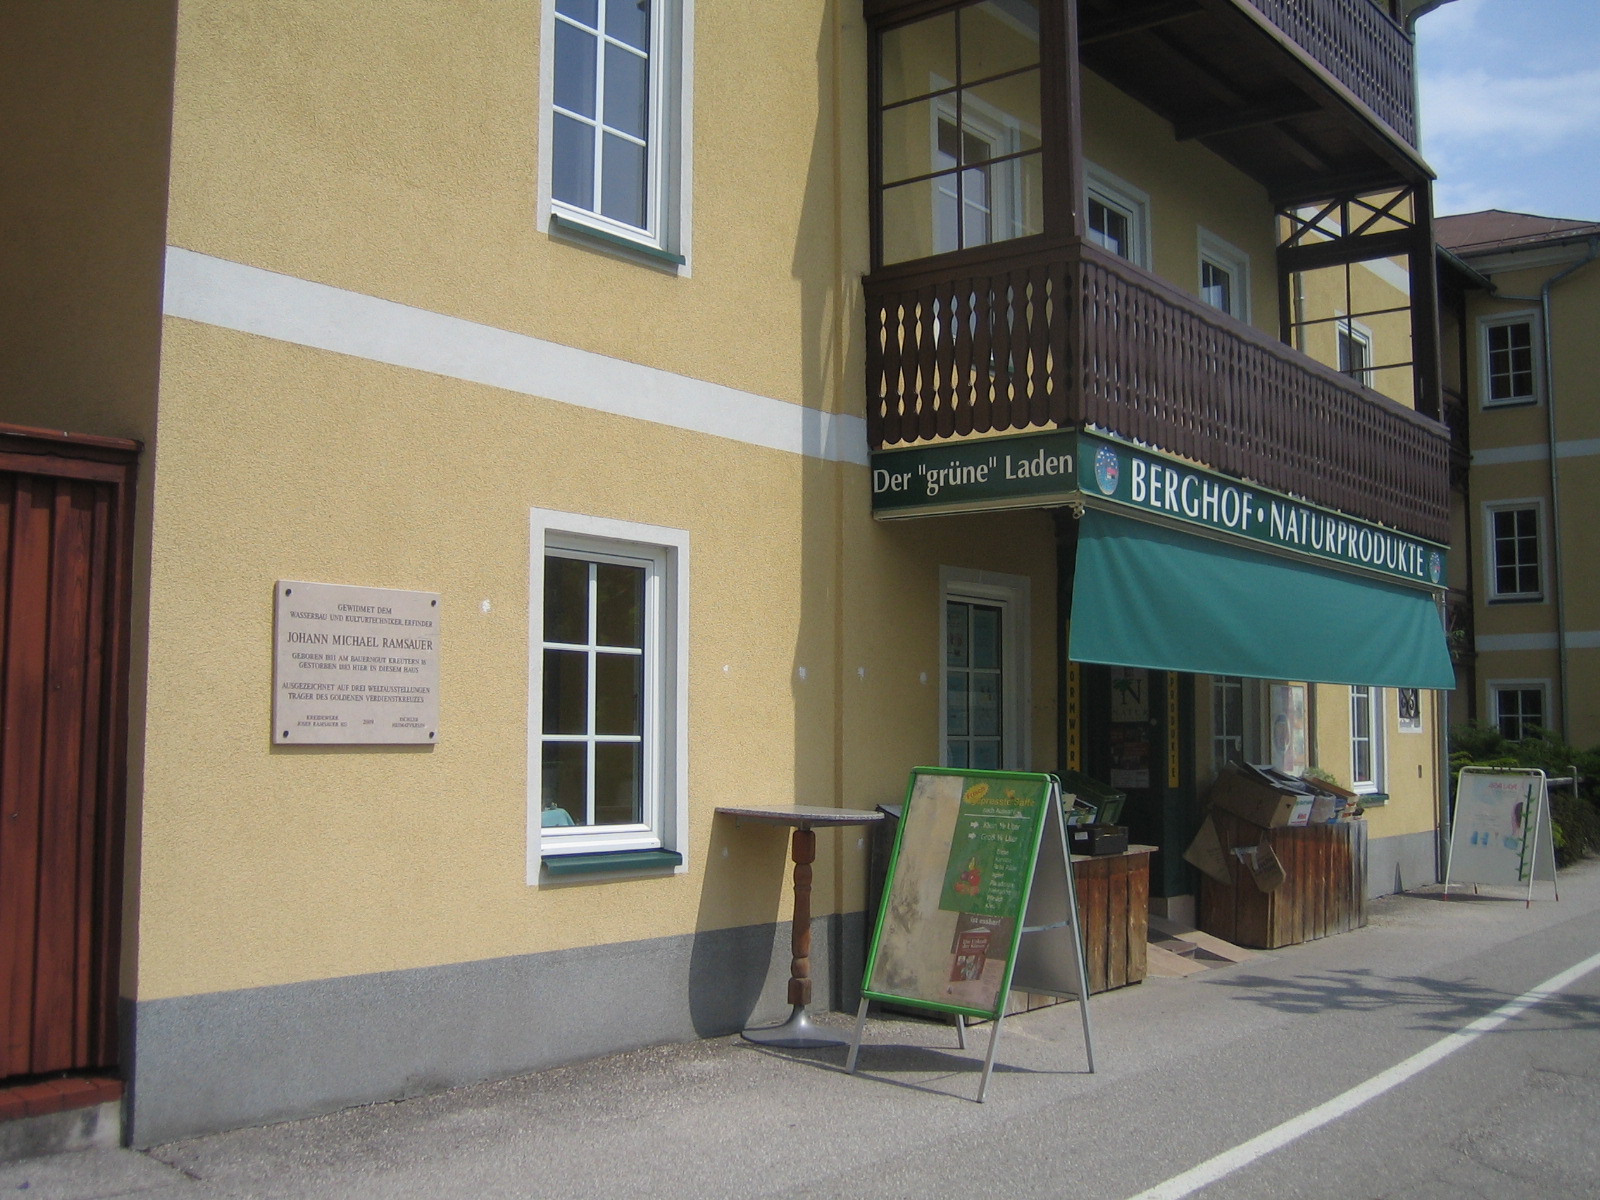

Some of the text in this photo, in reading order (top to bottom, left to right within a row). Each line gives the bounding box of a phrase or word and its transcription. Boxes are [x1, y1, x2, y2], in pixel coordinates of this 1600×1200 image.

[873, 449, 1073, 496] Der "grüne" Laden
[1131, 457, 1424, 577] BERGHOF NATURPRODUKTE
[337, 603, 392, 615] GEWIDMET DEM
[290, 611, 328, 621] WASSERBAU
[330, 613, 344, 622] UND
[404, 618, 433, 627] ERFINDER
[287, 632, 433, 650] JOHANN MICHAEL RAMSAUER
[291, 652, 324, 660] GEBOREN
[350, 655, 387, 664] BAUERNGUT
[388, 657, 419, 665] KREUTERN
[298, 661, 337, 670] GESTORBEN
[378, 665, 402, 673] DIESEM
[282, 682, 335, 691] AUSGEZEICHNET
[351, 684, 366, 692] DREI
[368, 684, 431, 693] WELTAUSSTELLUNGEN
[330, 693, 364, 702] GOLDENEN
[365, 694, 425, 703] VERDIENSTKREUZES
[1168, 670, 1177, 778] PRODUKTE
